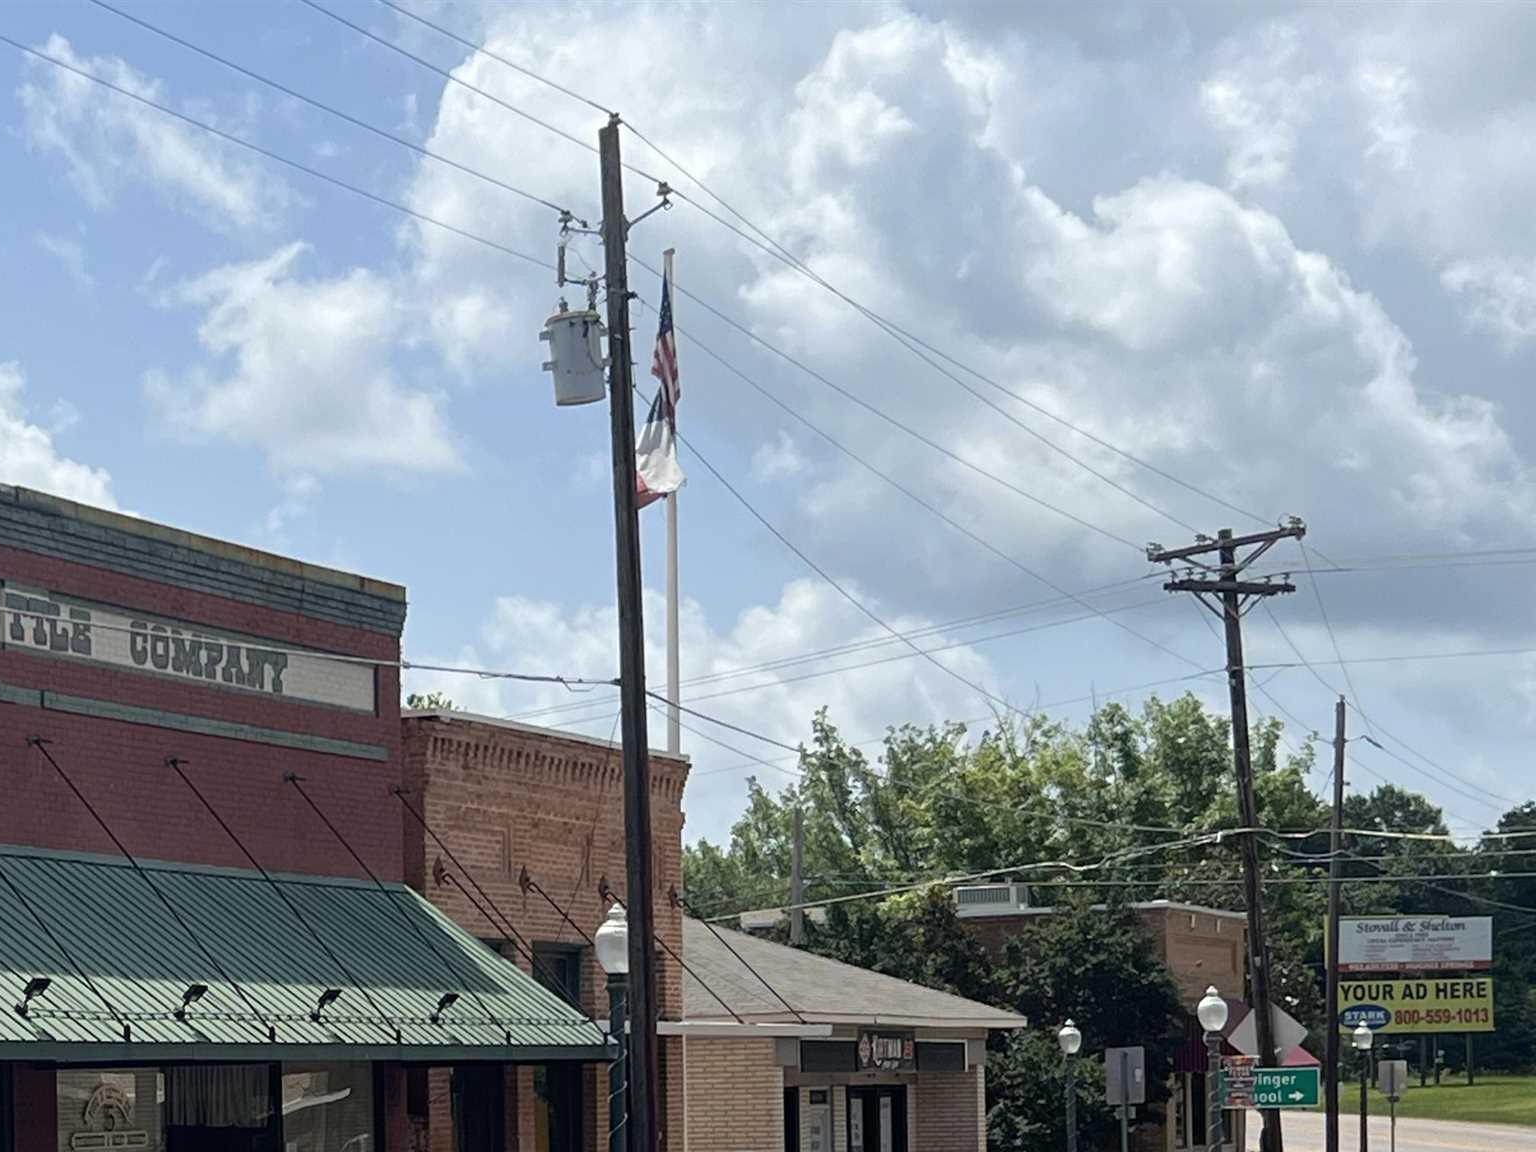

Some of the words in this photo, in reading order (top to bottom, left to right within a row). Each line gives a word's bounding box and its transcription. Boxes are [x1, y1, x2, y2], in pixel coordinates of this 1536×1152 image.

[130, 620, 289, 693] COMPANY
[1340, 984, 1394, 1001] YOUR
[1401, 983, 1428, 1000] AD
[1435, 981, 1488, 999] HERE
[1394, 1007, 1490, 1026] 800-559-1013
